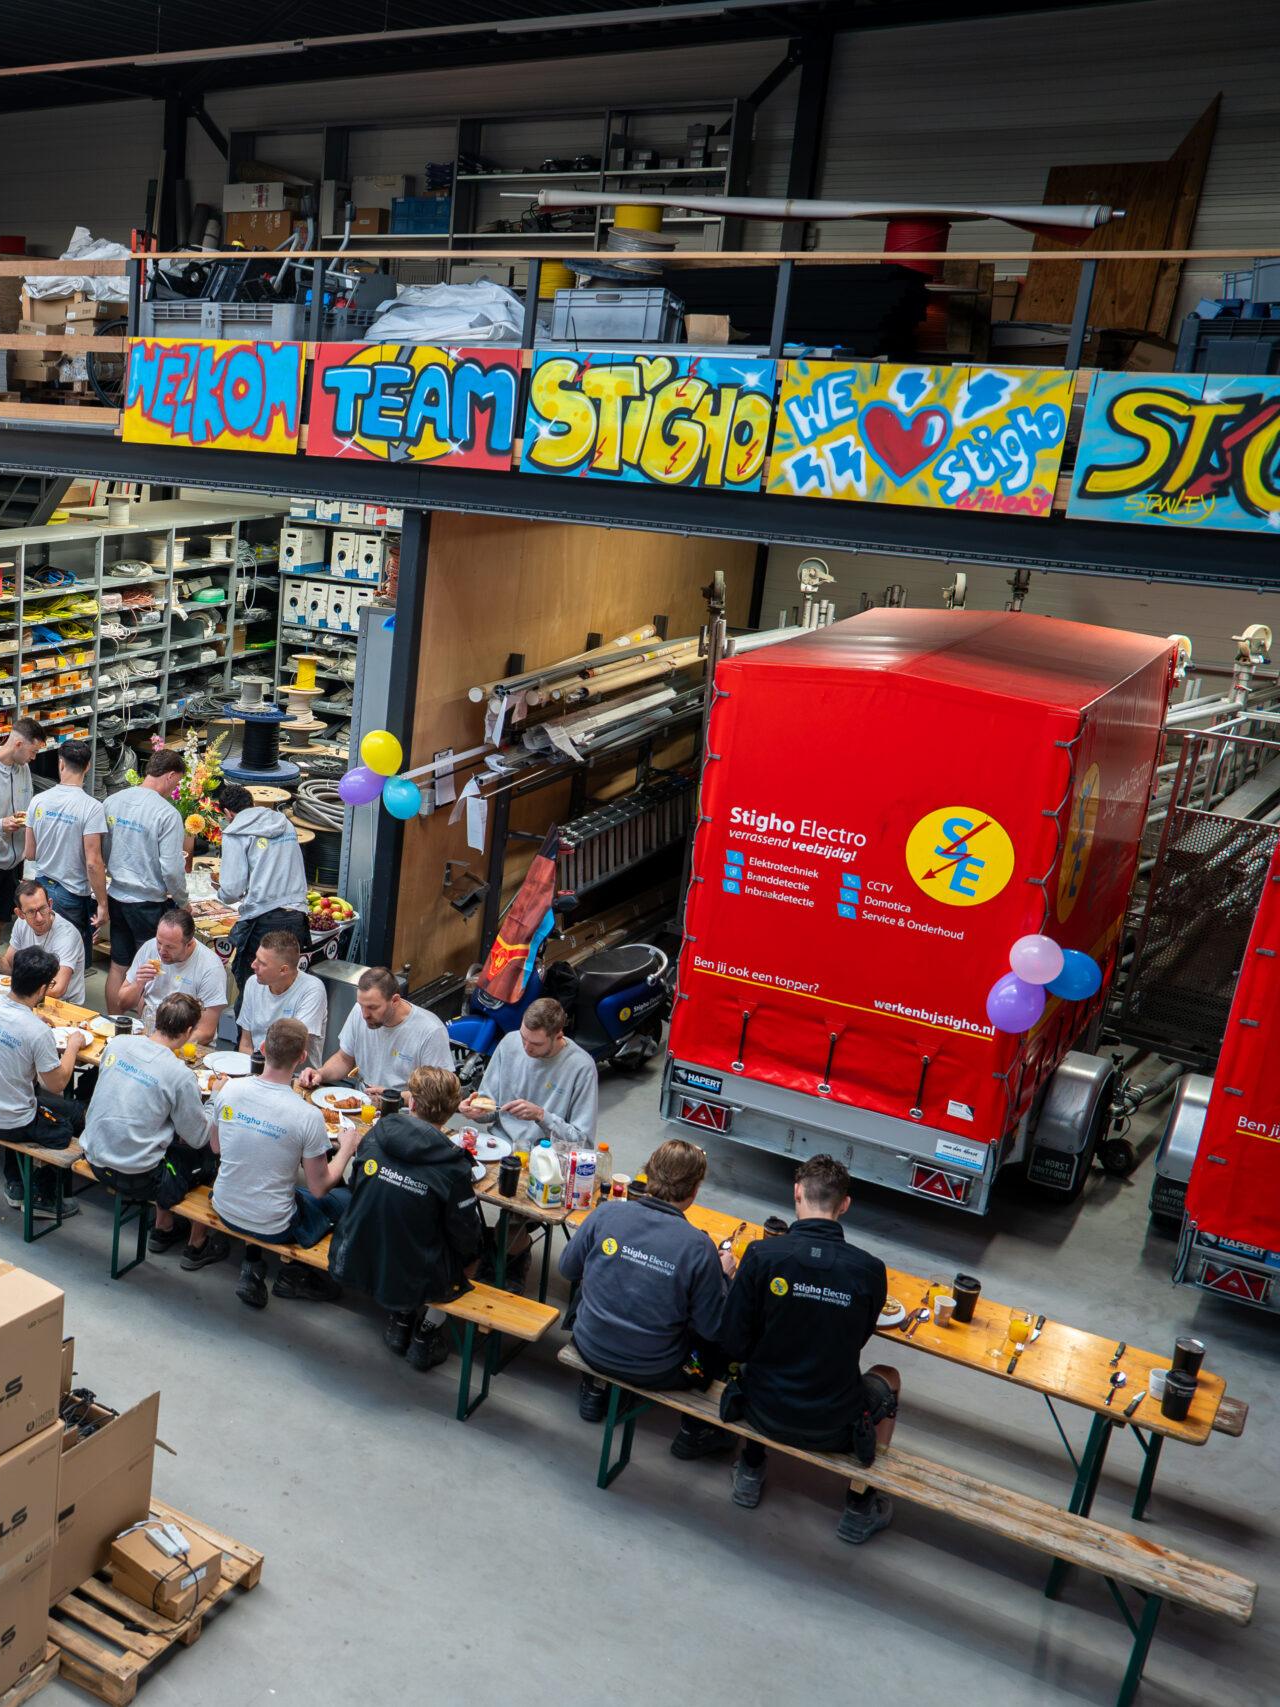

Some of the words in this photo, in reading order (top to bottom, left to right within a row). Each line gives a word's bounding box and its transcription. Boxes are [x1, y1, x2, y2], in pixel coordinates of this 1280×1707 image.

[323, 362, 516, 454] TEAM
[786, 371, 858, 441] WE
[1123, 488, 1217, 520] STANLEY
[729, 806, 796, 833] Stigho
[800, 819, 867, 847] Electro
[728, 828, 791, 849] verrassend
[791, 840, 858, 863] veelzijdig!
[749, 856, 819, 879] Elektrotechniek
[746, 871, 810, 892] Branddetectie
[866, 880, 894, 894] CCTV
[744, 885, 815, 908] Inbraakdetectie
[864, 895, 912, 913] Domotica
[861, 909, 896, 926] Service
[897, 917, 906, 928] &
[906, 920, 965, 941] Onderhoud
[218, 941, 231, 951] 40
[328, 945, 337, 955] 40
[298, 961, 307, 971] 40
[693, 955, 715, 969] Ben
[716, 960, 727, 975] jij
[728, 965, 750, 979] ook
[751, 972, 773, 983] een
[774, 975, 821, 994] topper?
[873, 998, 996, 1037] werkenbijstigho.nl
[687, 1072, 722, 1088] HAPERT
[236, 1111, 261, 1126] Stigho
[261, 1120, 287, 1135] Electro
[1237, 1116, 1266, 1133] Ben
[380, 1166, 404, 1182] Stigho
[404, 1175, 429, 1190] Electro
[621, 1245, 649, 1260] Stigho
[649, 1255, 676, 1270] Electro
[1218, 1236, 1266, 1256] HAPERT
[793, 1282, 822, 1294] Stigho
[822, 1287, 852, 1301] Electro
